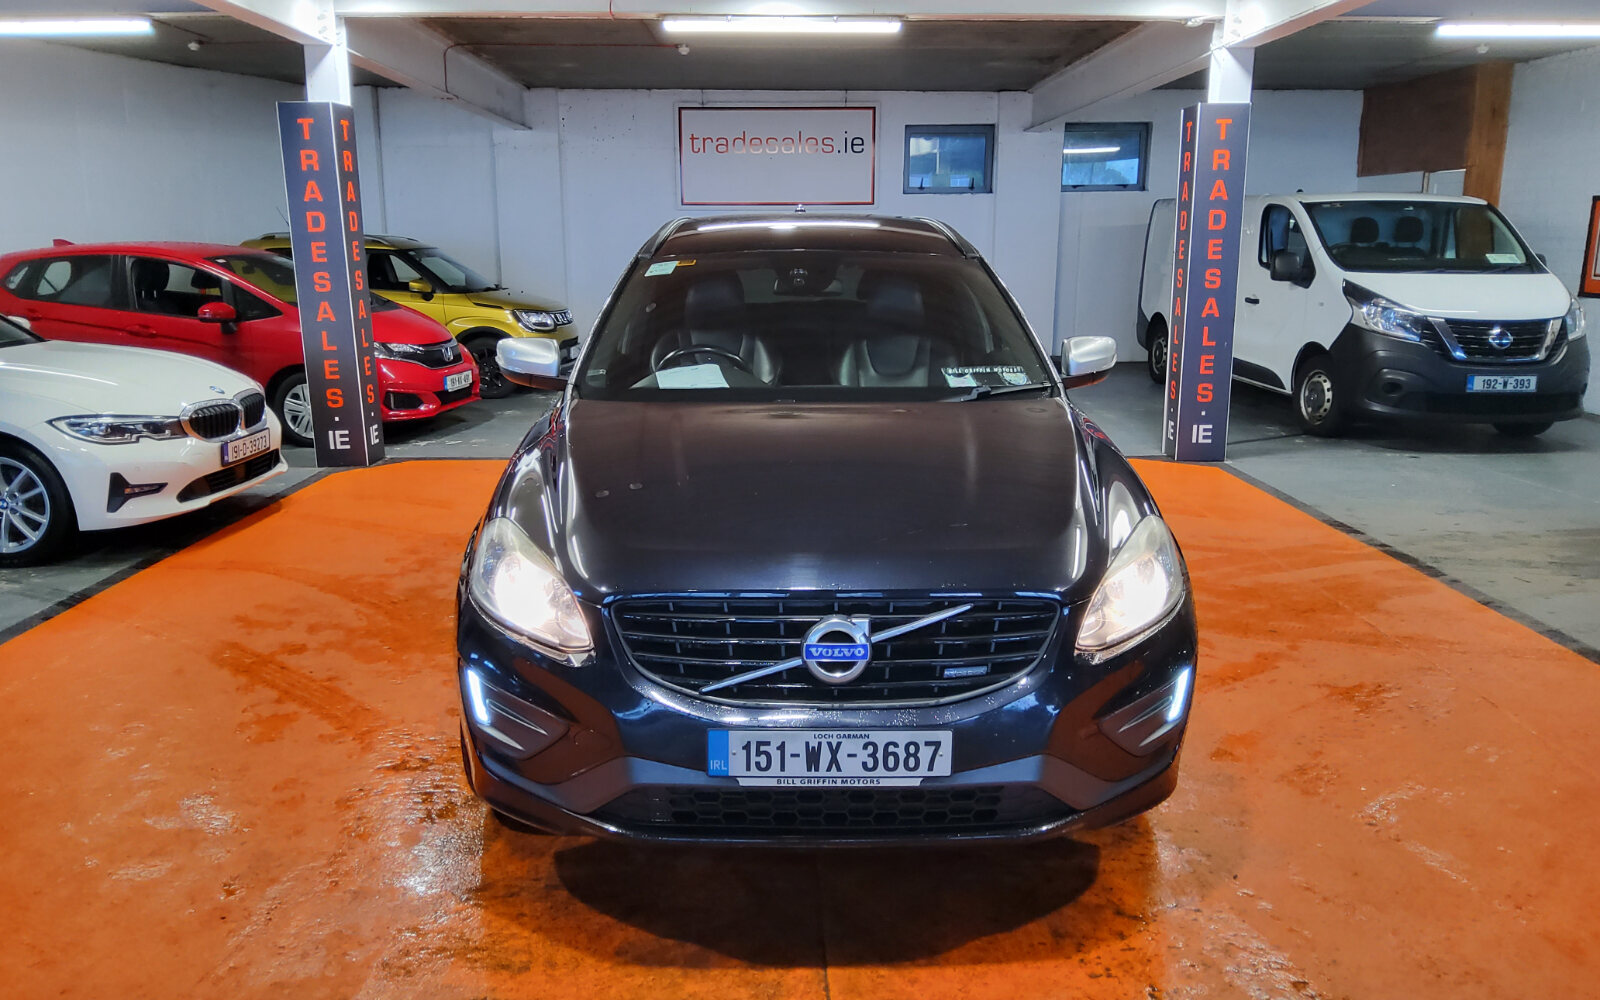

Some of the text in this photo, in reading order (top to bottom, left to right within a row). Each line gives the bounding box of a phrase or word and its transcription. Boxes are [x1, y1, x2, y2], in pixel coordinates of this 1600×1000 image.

[689, 130, 865, 154] tradesales.ie
[1481, 378, 1532, 390] 192-W-393
[231, 434, 268, 460] 191-D-39273
[808, 647, 865, 657] VOLVO
[709, 740, 942, 773] IRL 151-WX-3687
